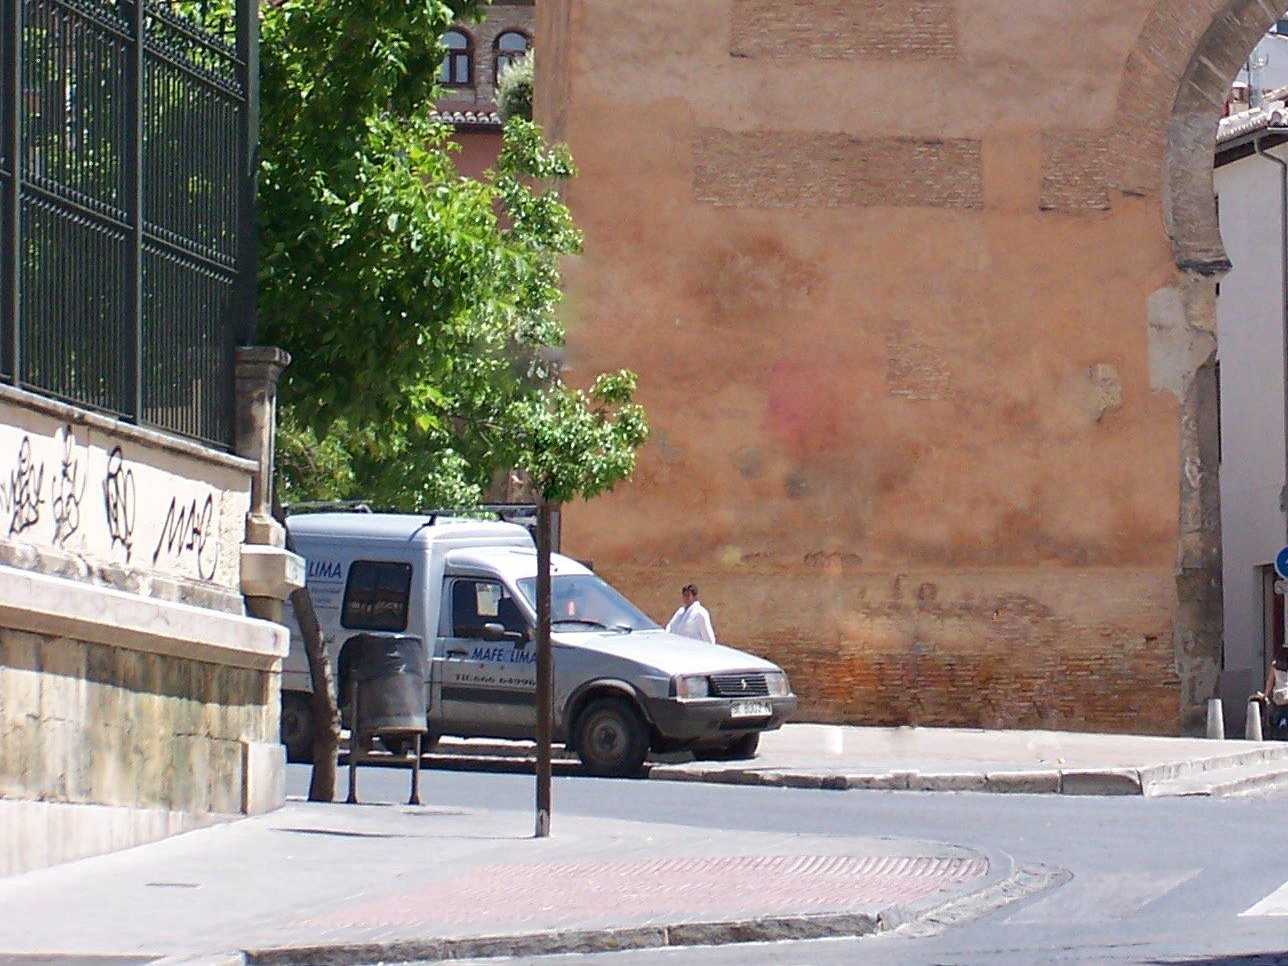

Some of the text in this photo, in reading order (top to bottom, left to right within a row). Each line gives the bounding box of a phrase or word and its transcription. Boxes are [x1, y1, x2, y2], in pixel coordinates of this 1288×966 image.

[308, 561, 342, 578] LIMA
[472, 647, 537, 664] MAFE LIMA
